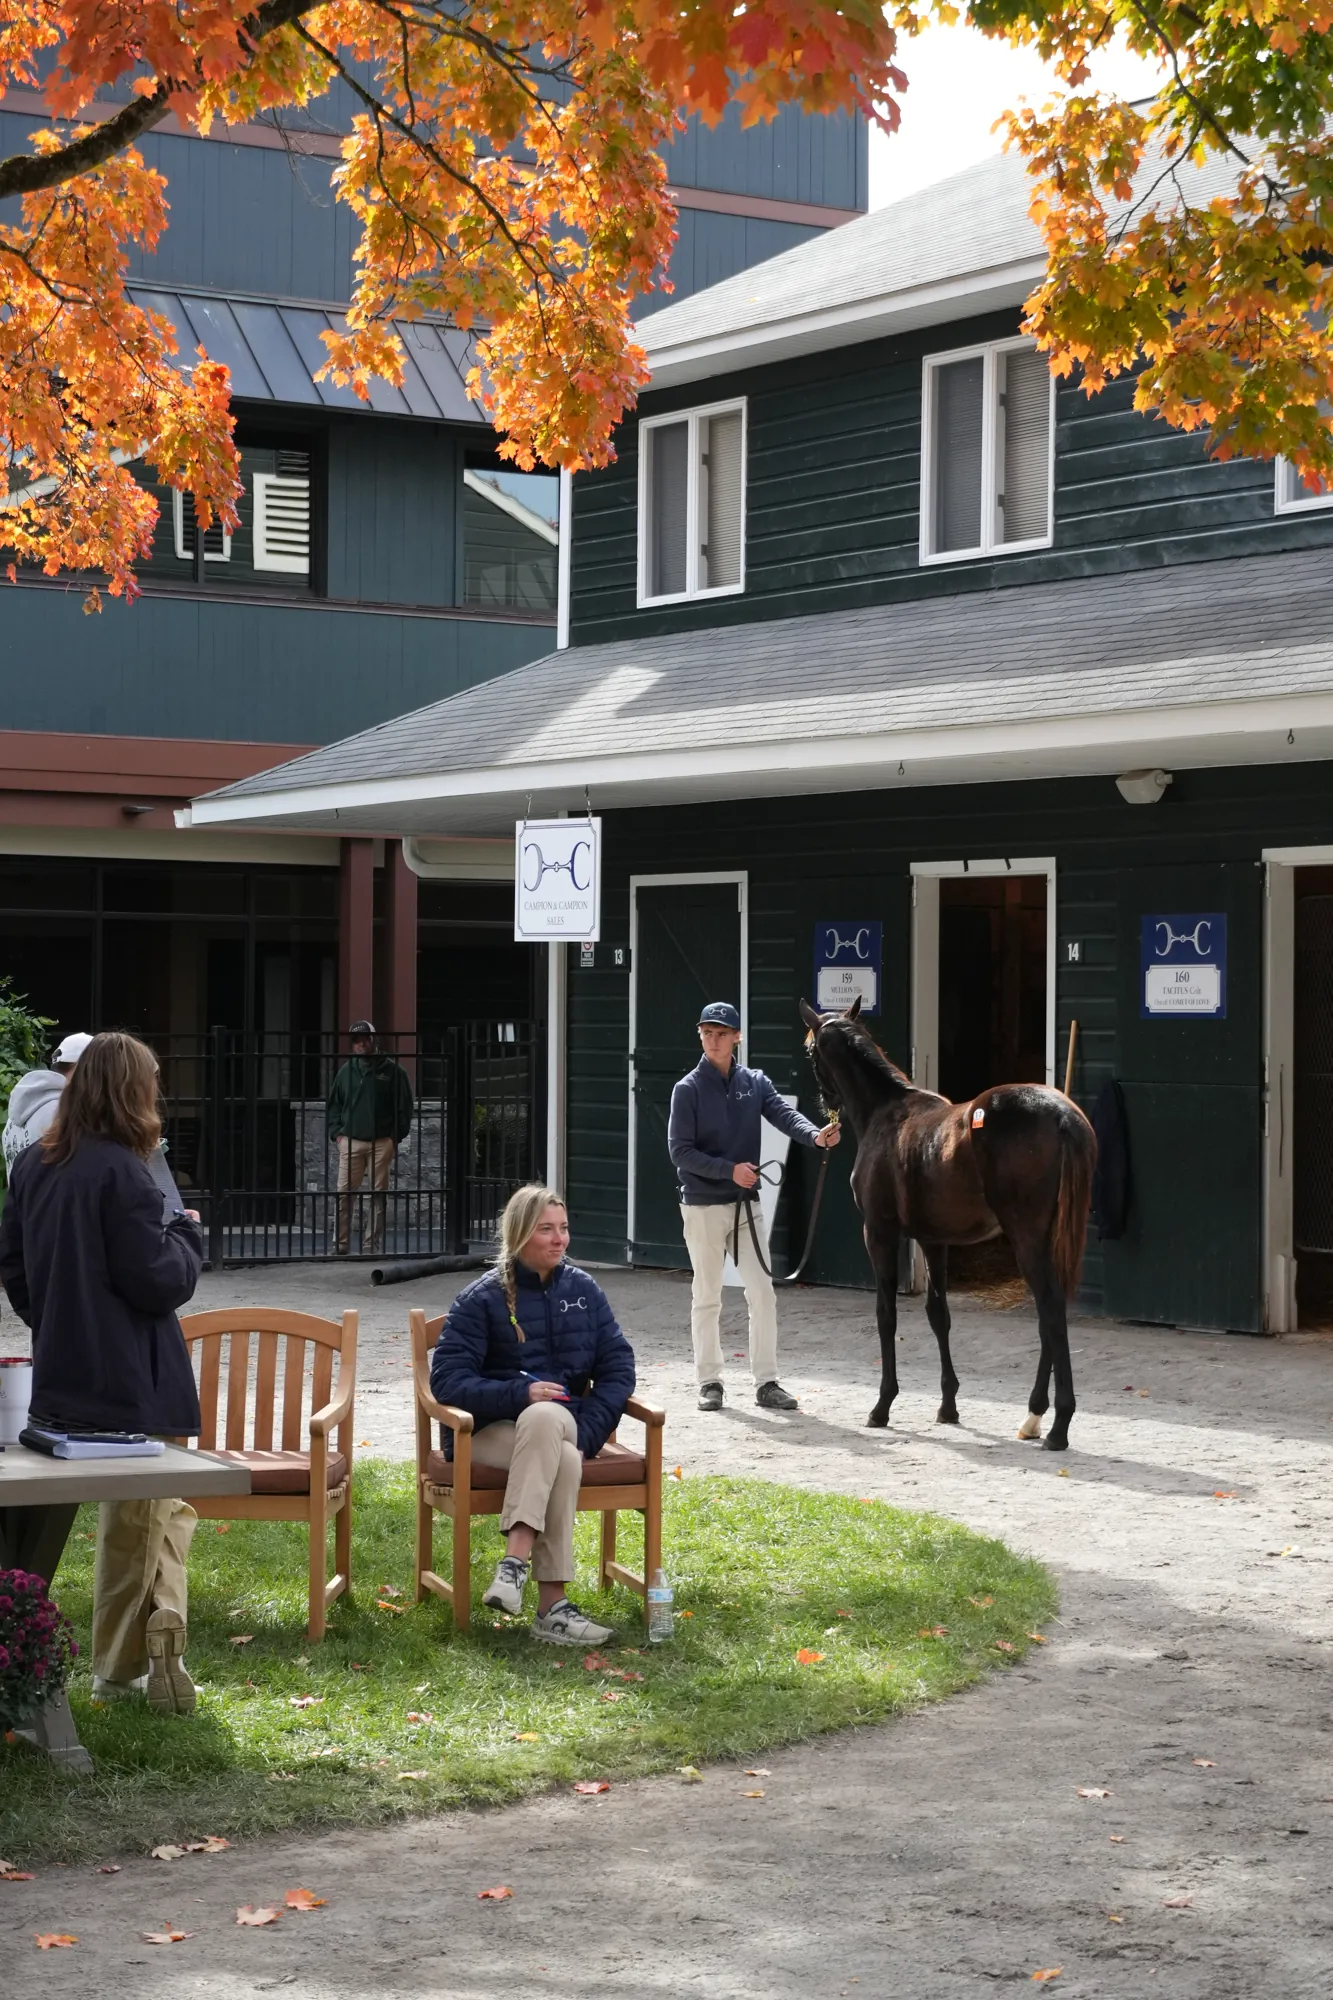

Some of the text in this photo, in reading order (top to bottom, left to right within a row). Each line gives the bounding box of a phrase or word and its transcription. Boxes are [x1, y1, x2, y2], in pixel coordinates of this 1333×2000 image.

[524, 900, 588, 910] CAMPION & CAMPION
[546, 916, 565, 925] SALES
[614, 948, 623, 965] 13
[1067, 942, 1079, 961] 14
[842, 972, 853, 984] 159
[1175, 971, 1189, 983] 160
[1163, 987, 1188, 995] TACITUS
